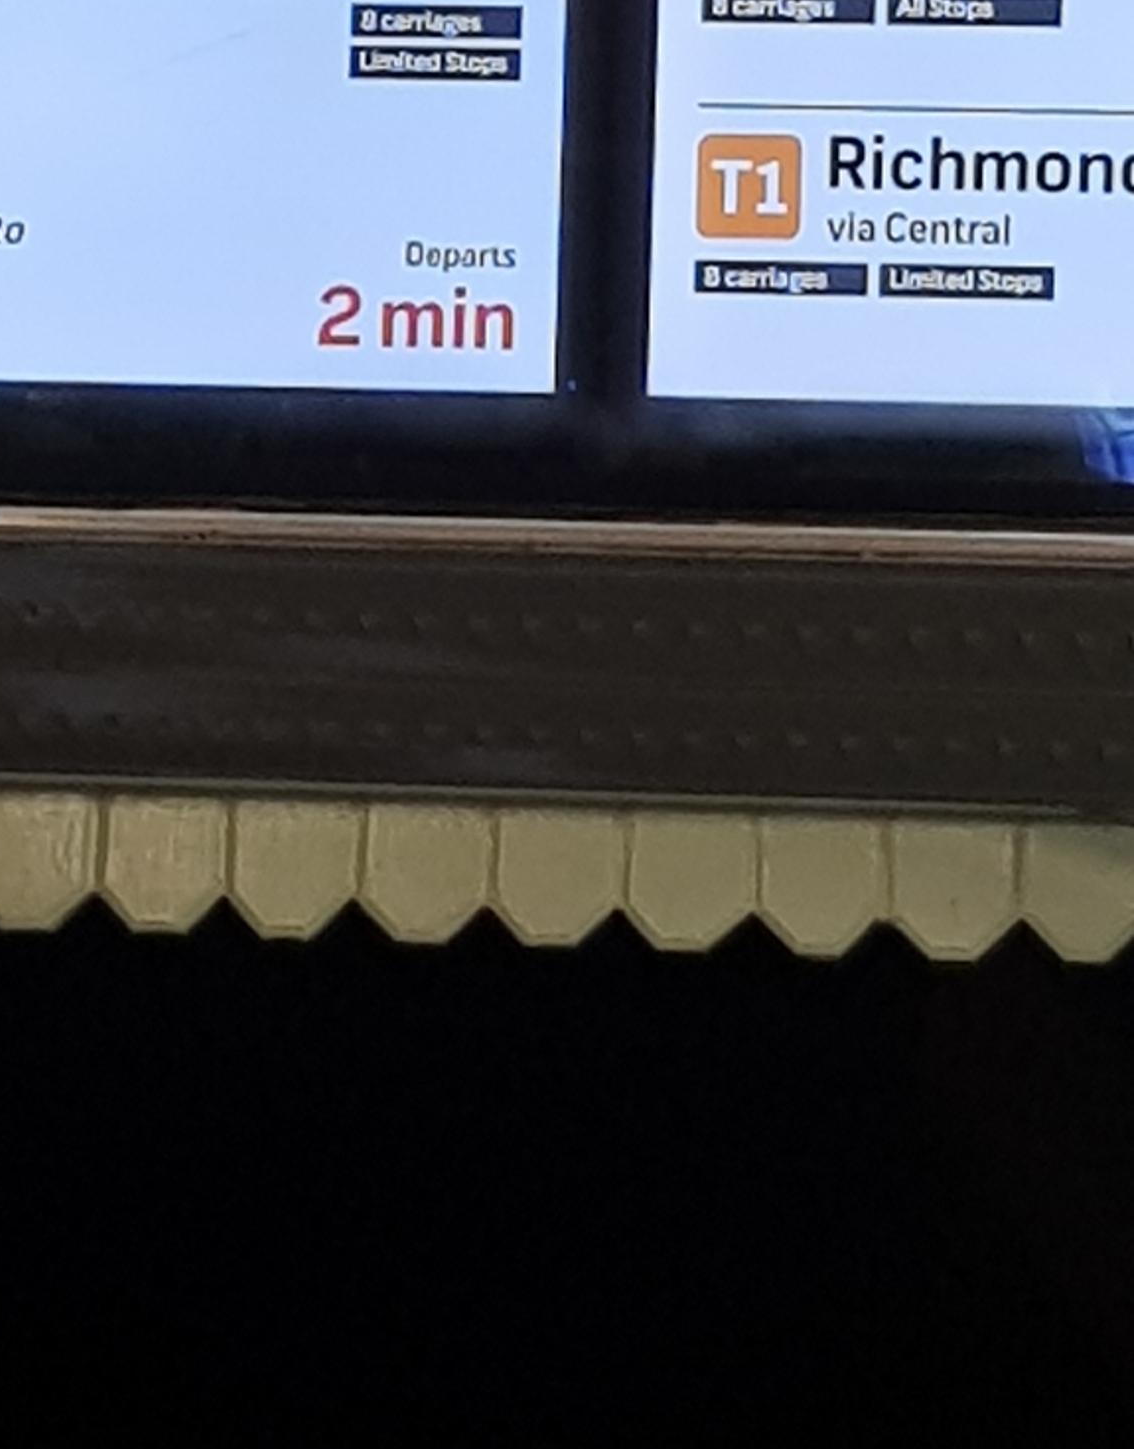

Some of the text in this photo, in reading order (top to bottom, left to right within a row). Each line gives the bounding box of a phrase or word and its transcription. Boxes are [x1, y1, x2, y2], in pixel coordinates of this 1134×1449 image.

[380, 9, 482, 38] carriages
[359, 50, 509, 76] Limited Stops
[710, 159, 788, 215] T1
[827, 212, 1011, 245] via Central
[405, 240, 516, 272] Departs
[723, 266, 829, 294] carriages
[889, 267, 1044, 295] Limited Stops
[318, 285, 513, 350] 2 min
